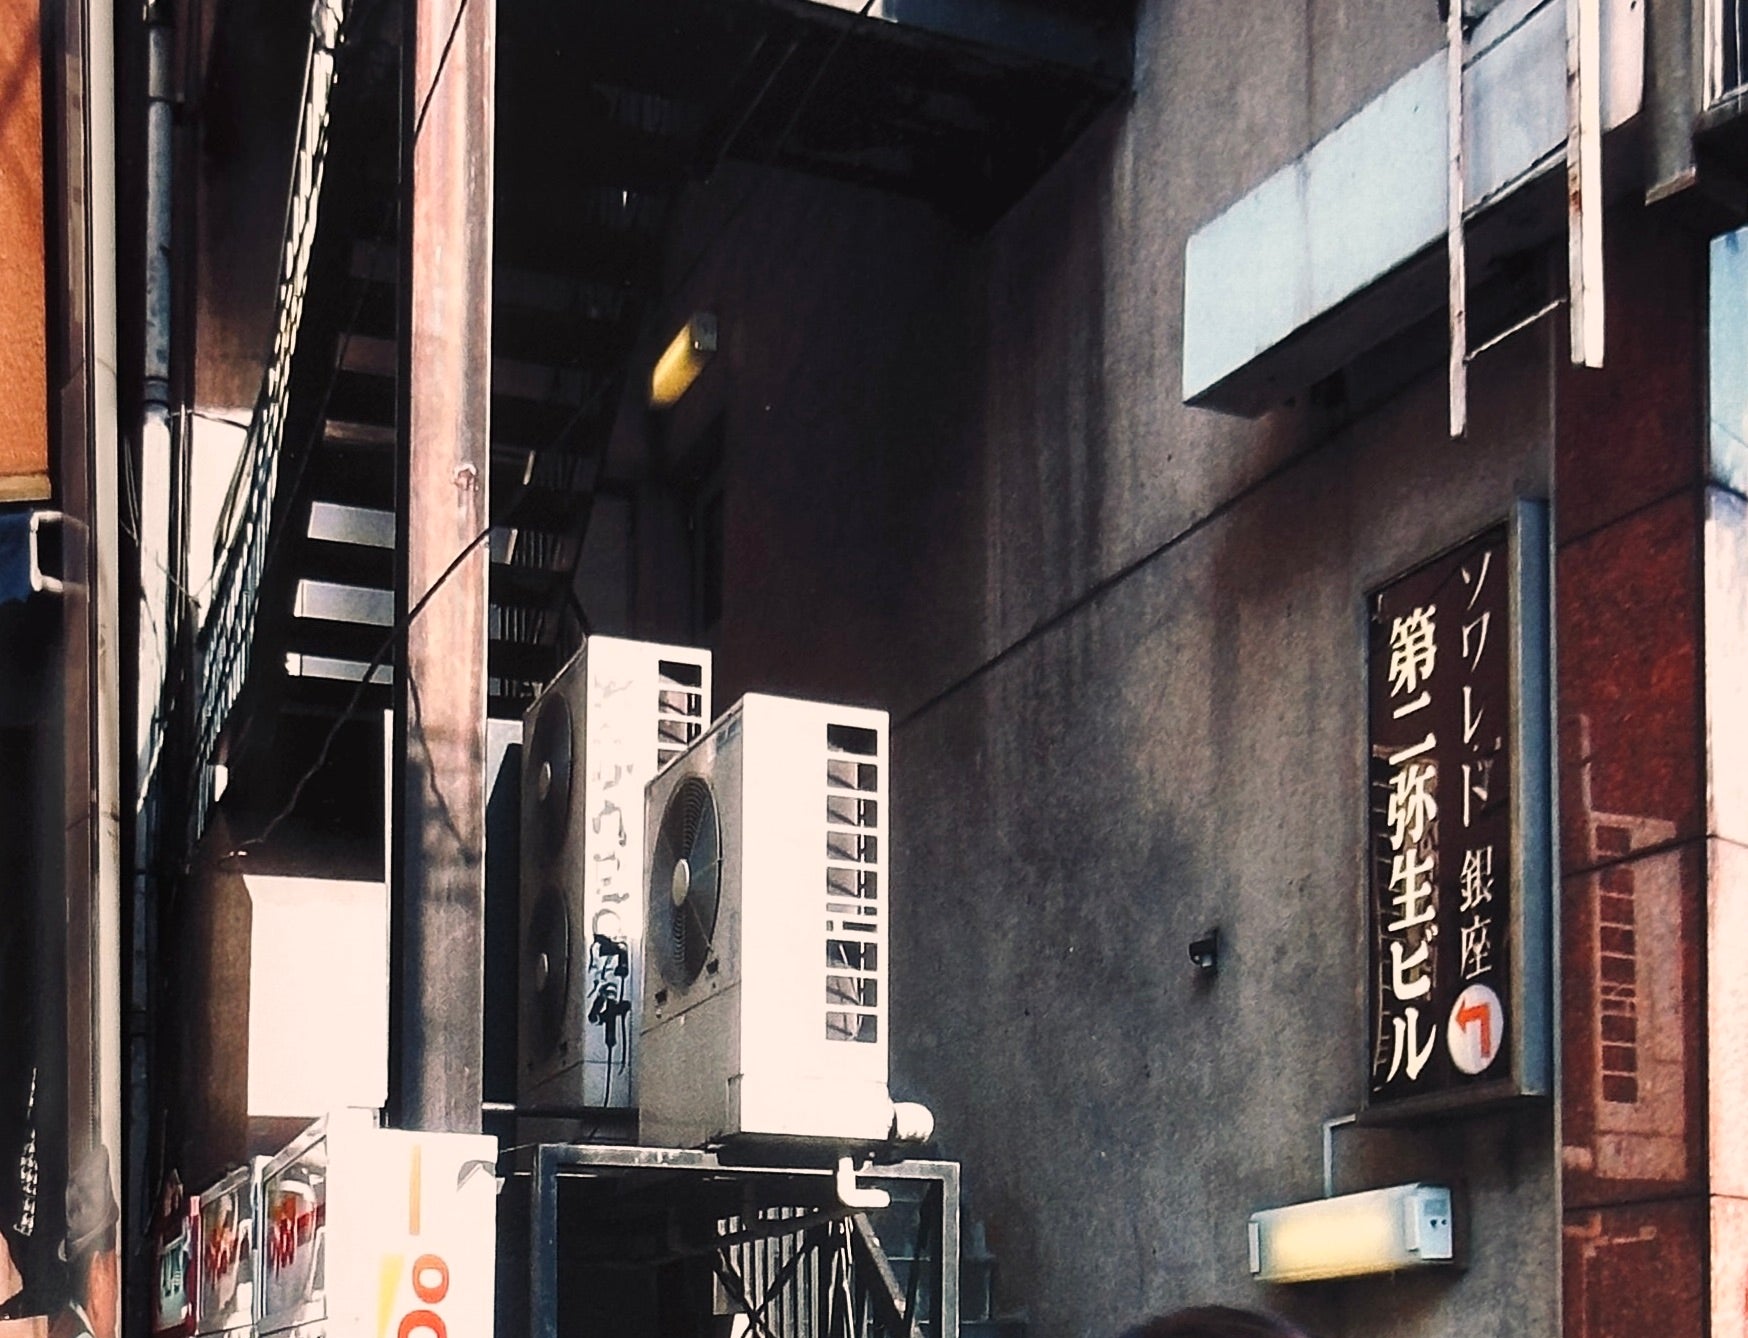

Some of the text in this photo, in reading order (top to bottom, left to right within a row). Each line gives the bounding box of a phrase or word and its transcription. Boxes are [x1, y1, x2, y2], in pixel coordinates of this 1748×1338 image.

[1386, 604, 1438, 1082] 第二弥生ビル
